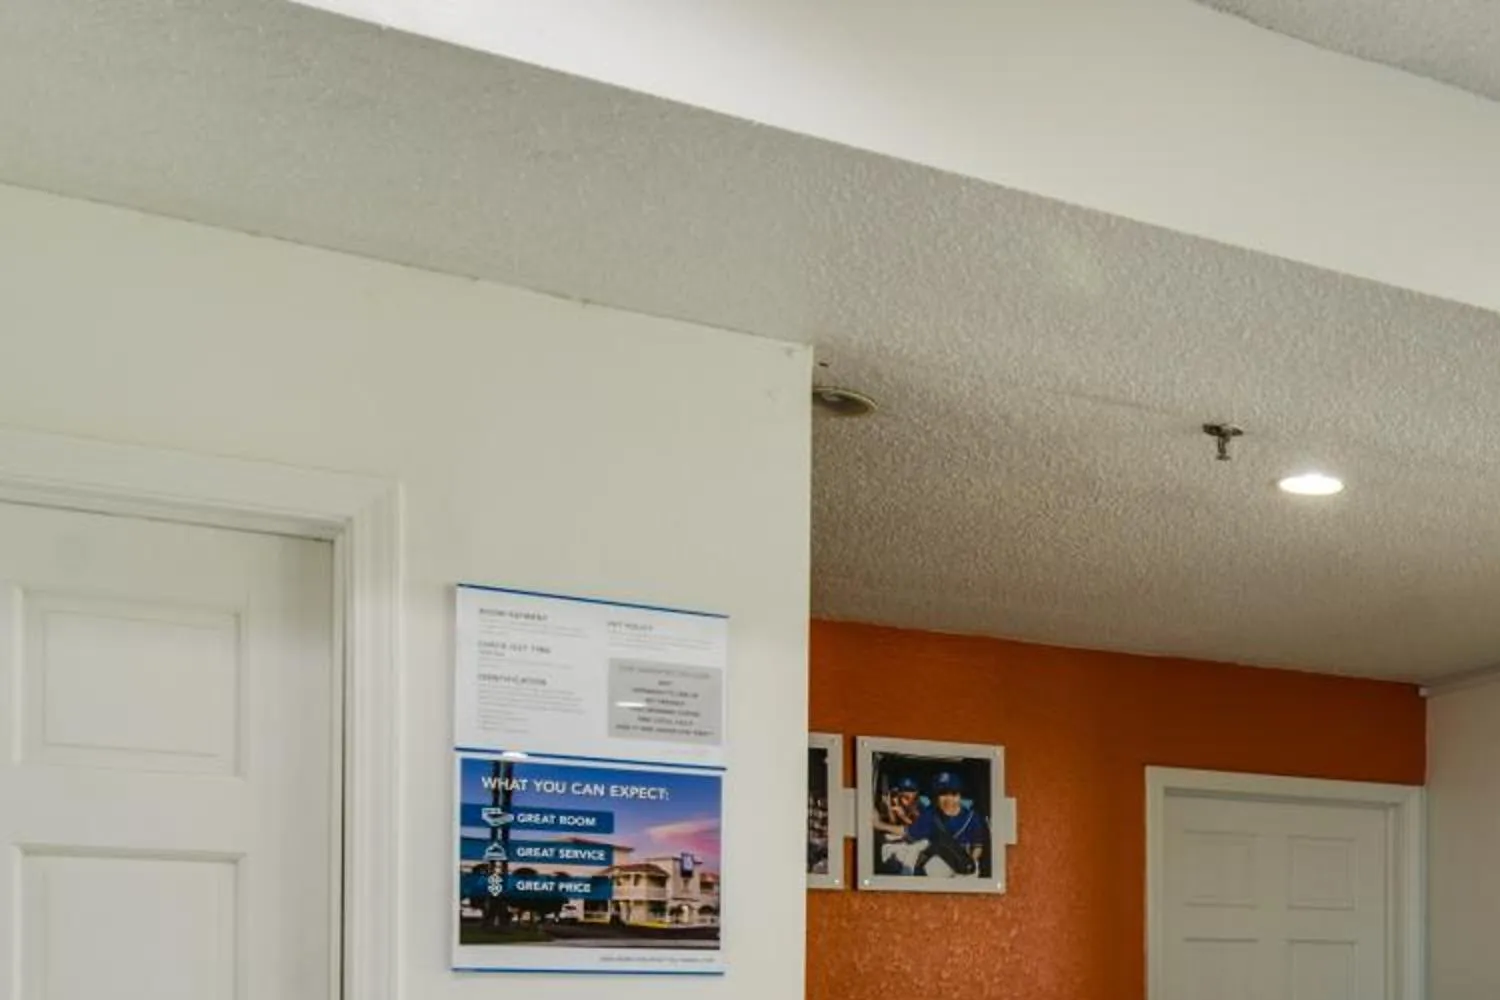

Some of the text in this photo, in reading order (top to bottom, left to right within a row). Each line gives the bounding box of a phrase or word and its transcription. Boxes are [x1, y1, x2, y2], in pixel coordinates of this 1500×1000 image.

[481, 776, 670, 801] WHAT YOU CAN EXPECT:
[517, 813, 597, 826] GREAT ROOM
[517, 847, 606, 861] GREAT SERVICE
[516, 881, 591, 893] GREAT PRICE
